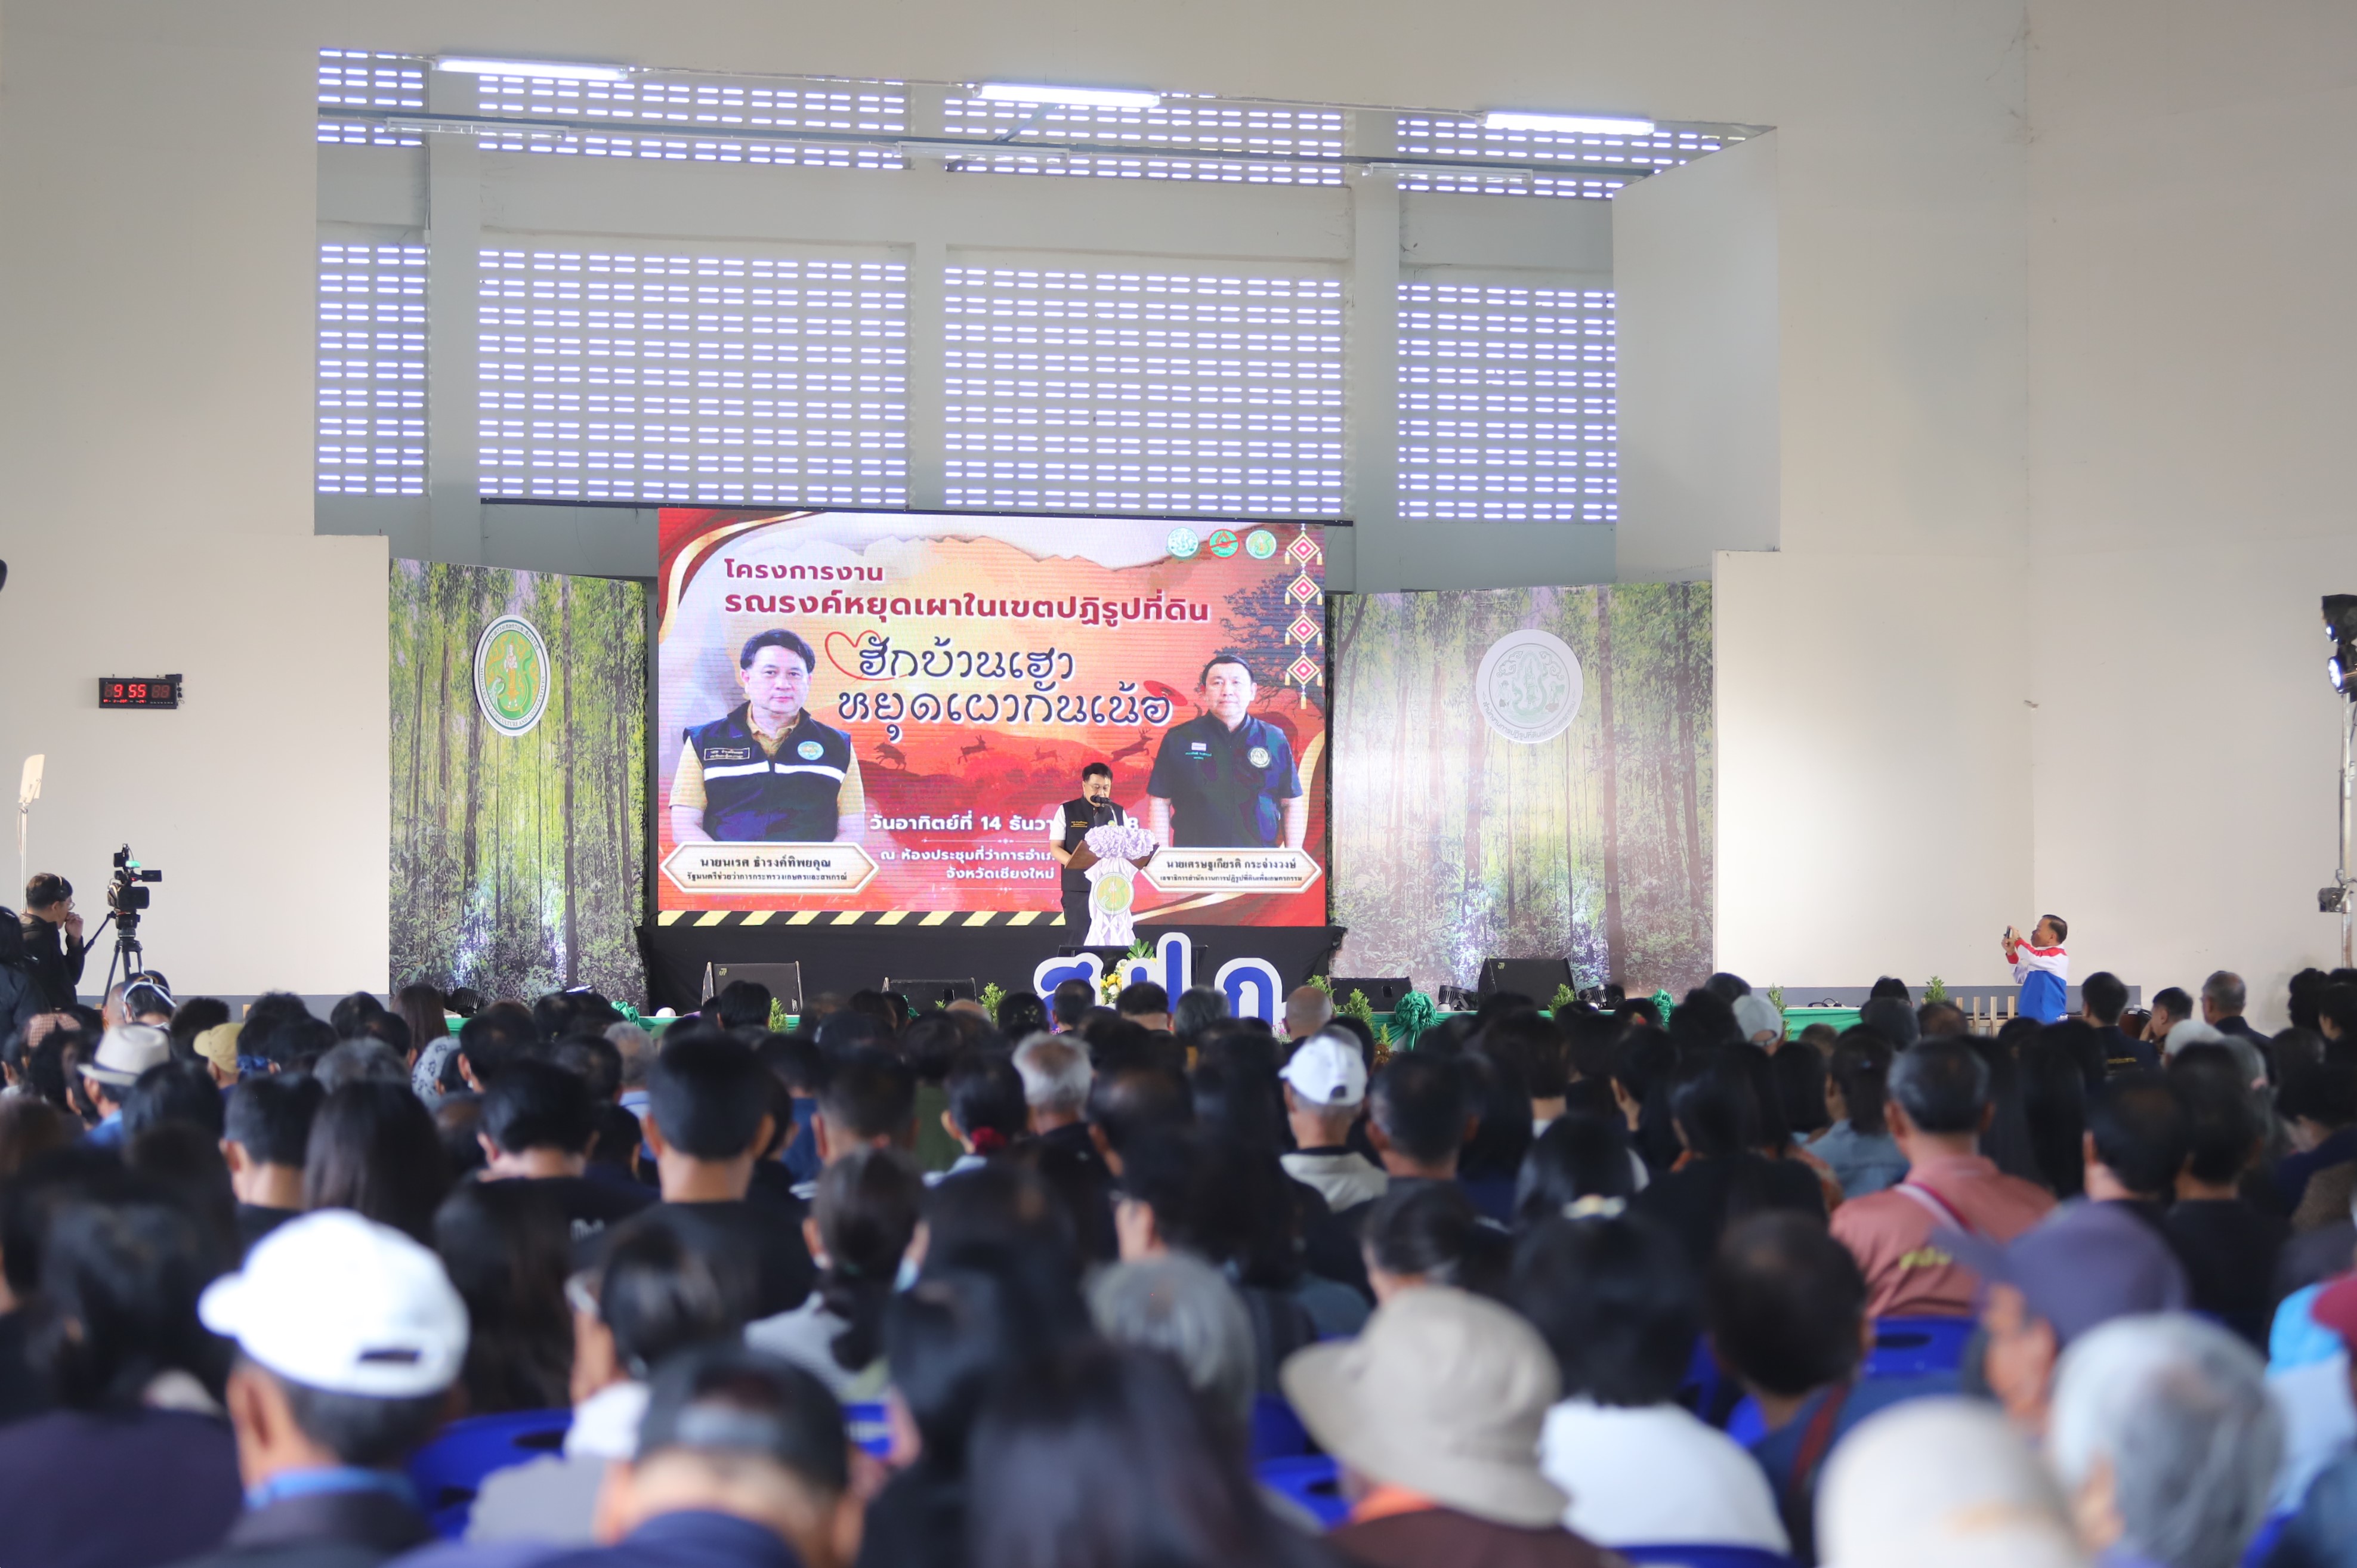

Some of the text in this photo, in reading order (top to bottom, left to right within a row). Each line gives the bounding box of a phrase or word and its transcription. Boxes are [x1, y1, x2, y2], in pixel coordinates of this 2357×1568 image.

[724, 558, 883, 581] โครงการงาน
[725, 589, 1208, 627] รณรงค์หยุดเผาในเขตปฏิรูปที่ดิน
[859, 636, 1074, 679] ฮักบ้านเฮา
[114, 684, 146, 698] 9 55
[486, 699, 492, 708] OF
[490, 708, 518, 726] AGRICULTURE
[527, 676, 545, 719] COOPERATIVES
[838, 681, 1173, 741] หยุดเผากันเน้อ
[870, 811, 972, 830] วันอาทิตย์ที่
[981, 817, 1002, 830] 14
[1009, 815, 1054, 831] ธันวา
[700, 858, 749, 868] นายนเรศ
[881, 851, 895, 860] ณ
[946, 867, 1054, 879] จังหวัดเชียงใหม่
